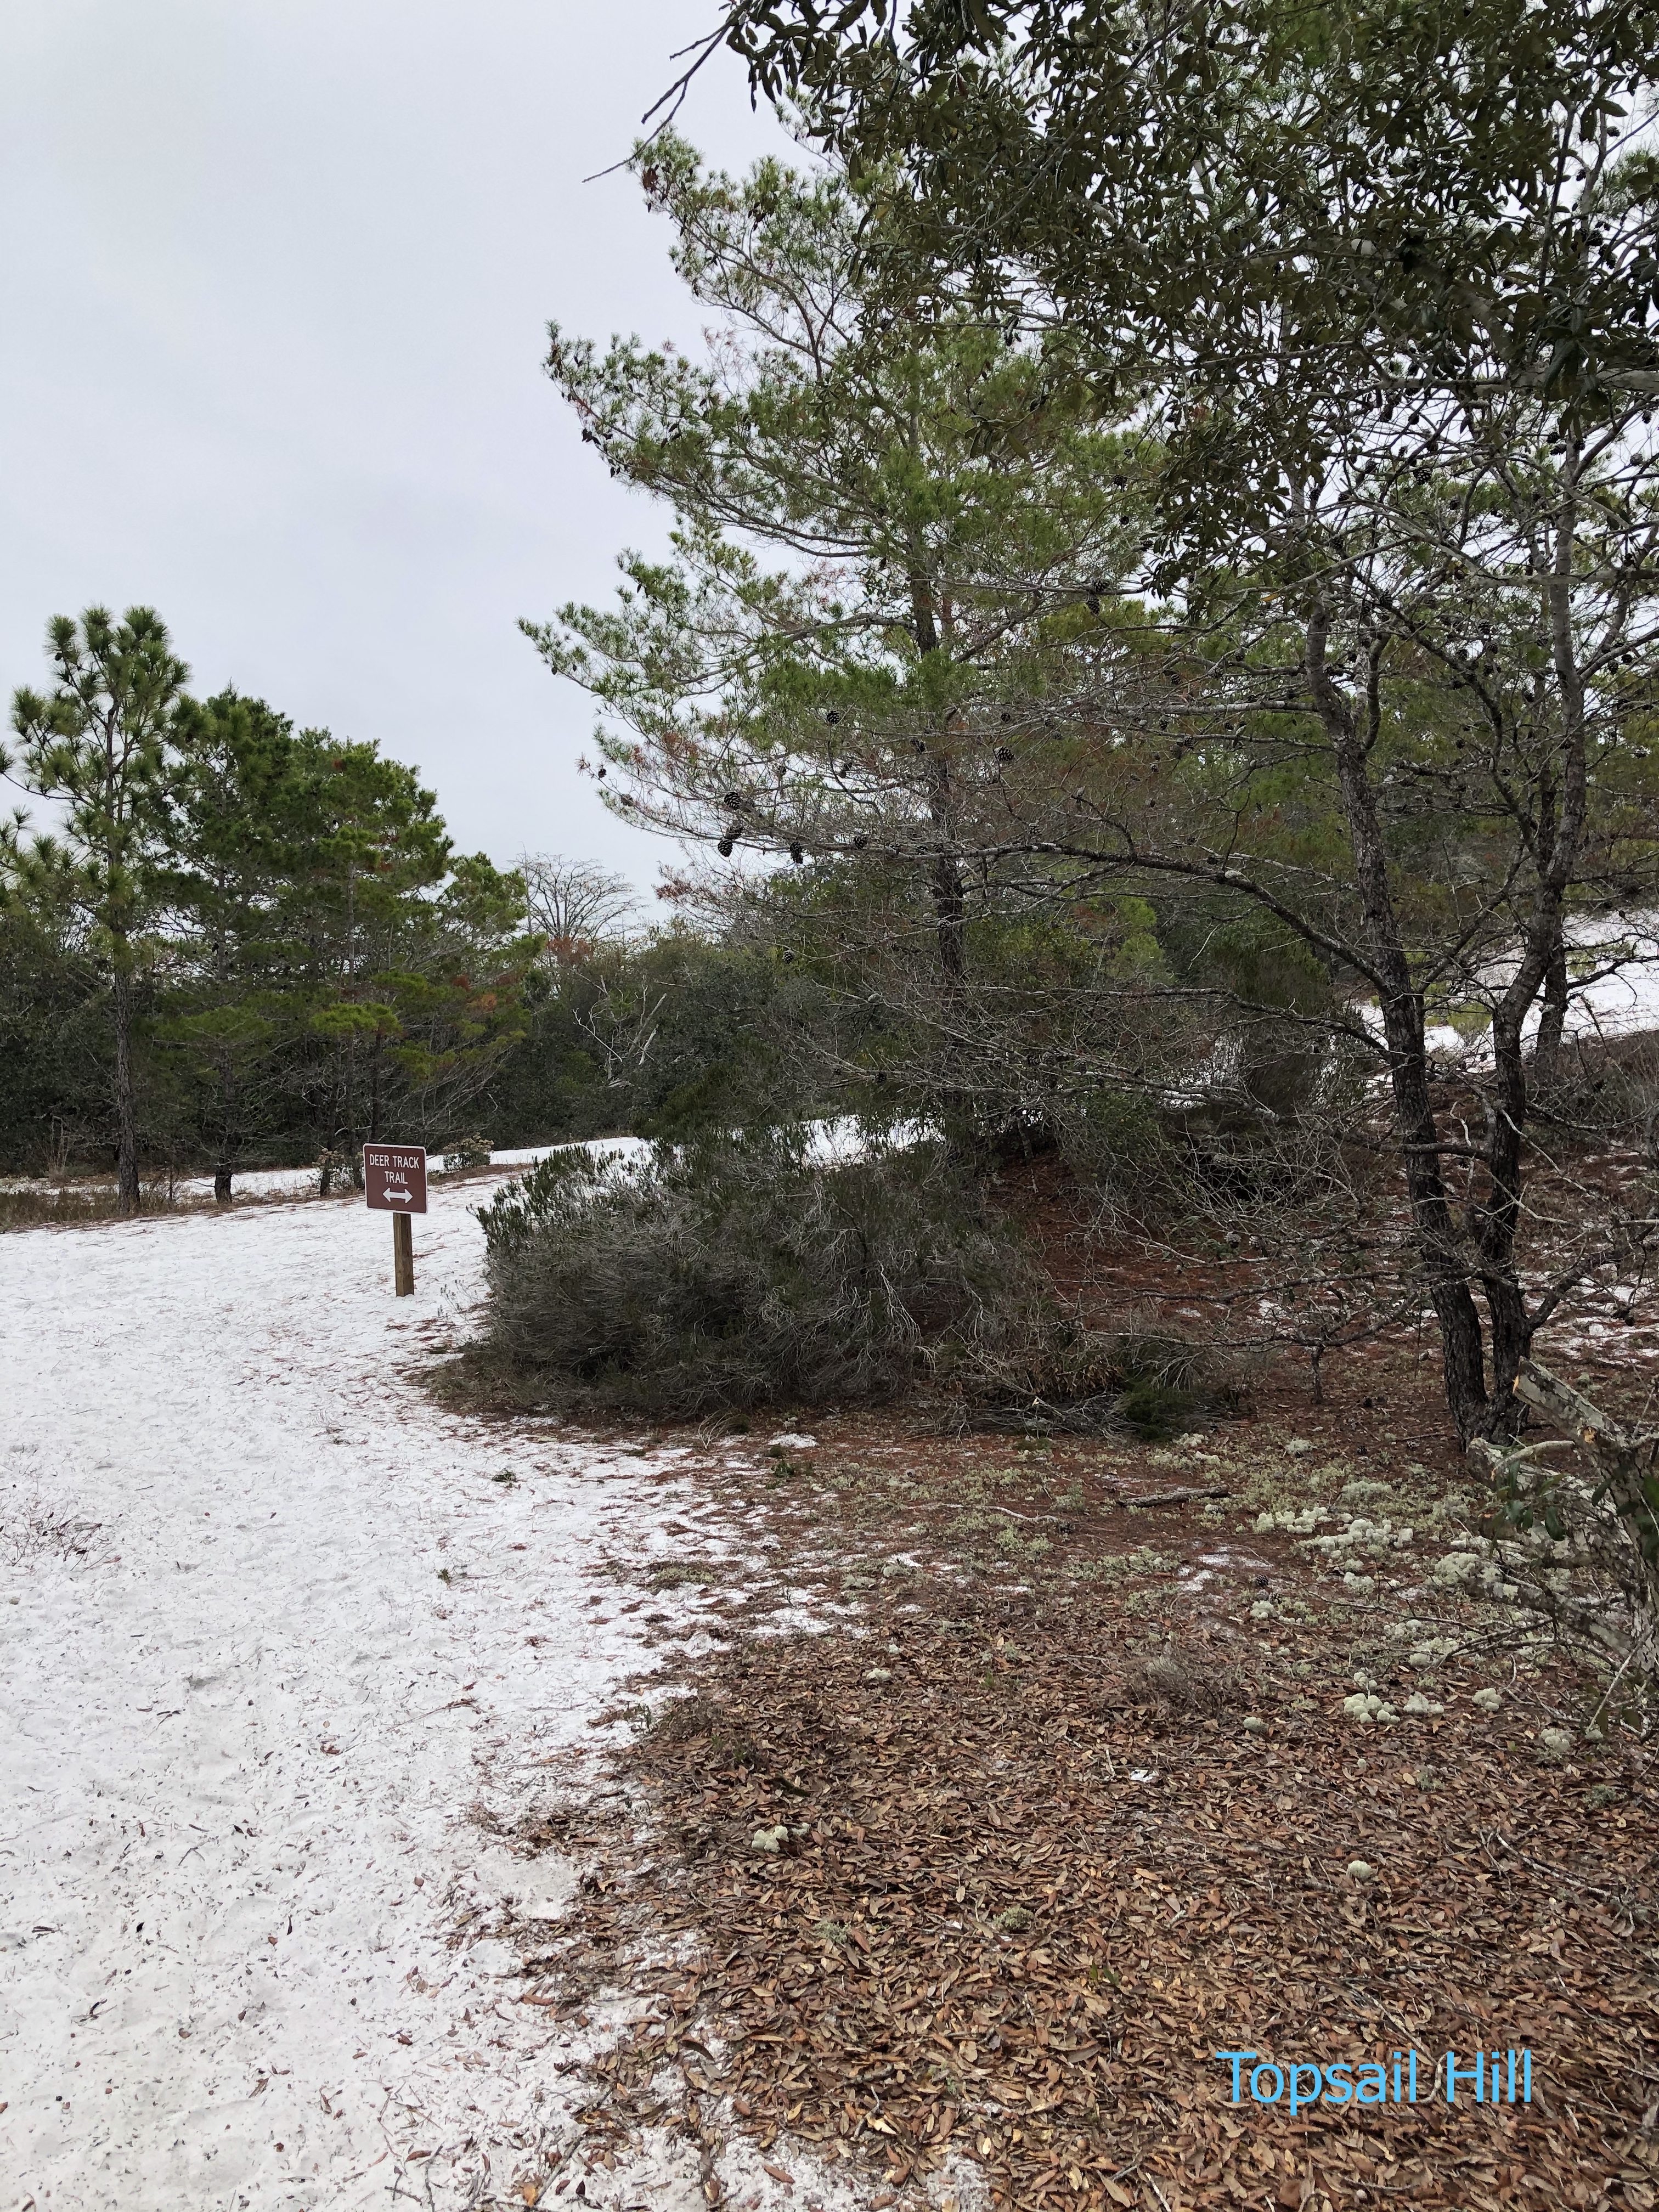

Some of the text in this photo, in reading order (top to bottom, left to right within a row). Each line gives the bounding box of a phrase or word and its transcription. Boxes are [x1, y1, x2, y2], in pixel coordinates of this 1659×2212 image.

[369, 1154, 420, 1169] DEER TRACK
[384, 1171, 408, 1184] TRAIL
